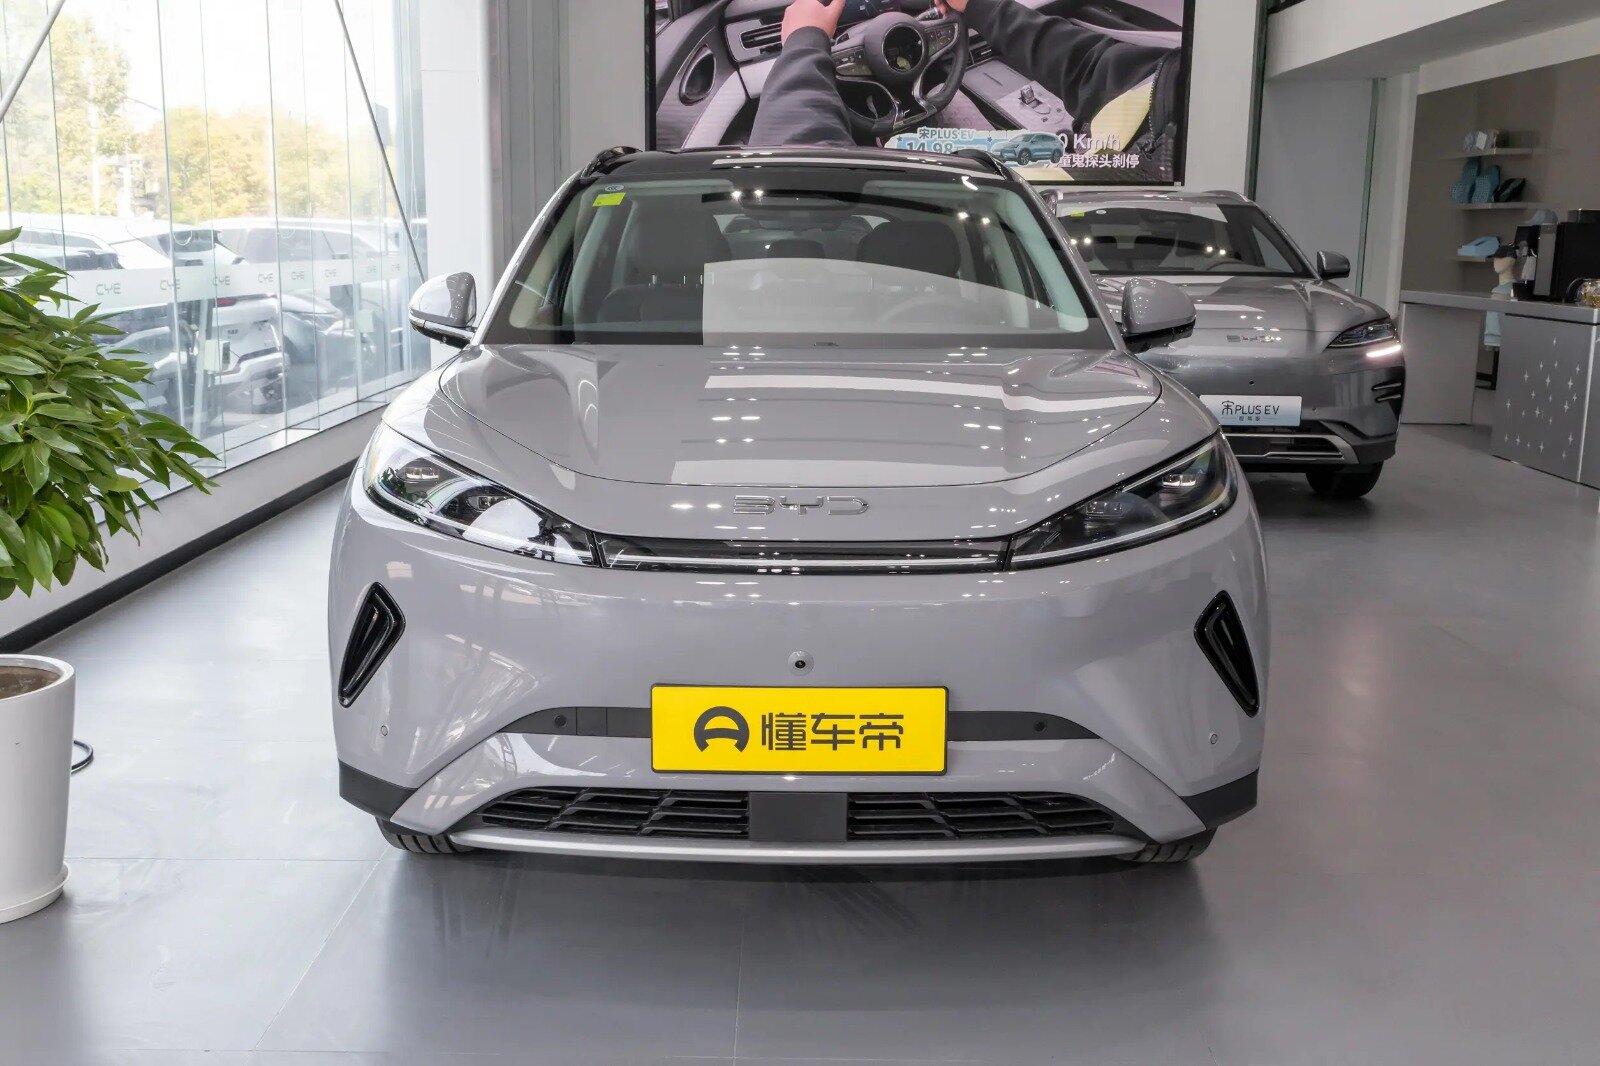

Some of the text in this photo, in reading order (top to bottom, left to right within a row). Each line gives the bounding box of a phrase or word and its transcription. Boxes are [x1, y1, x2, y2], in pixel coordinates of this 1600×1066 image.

[918, 128, 976, 140] 宋PLUS EV
[906, 141, 953, 154] 1498
[1264, 405, 1280, 415] EV
[733, 494, 869, 516] BYD
[761, 712, 904, 751] 懂车帝
